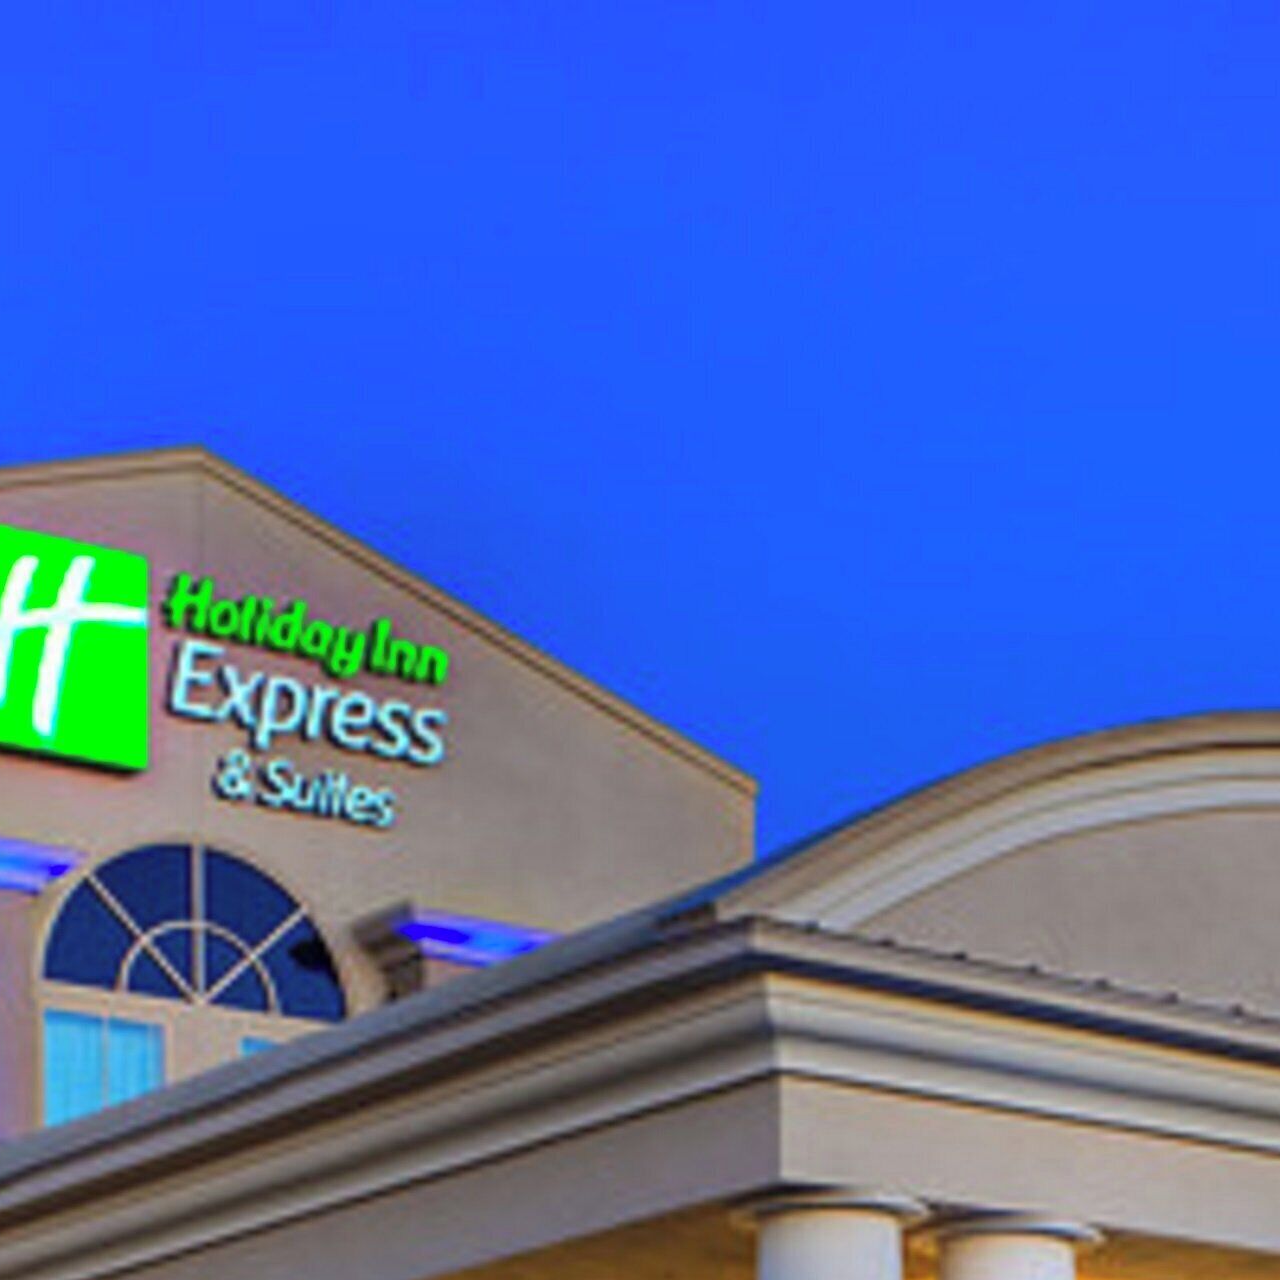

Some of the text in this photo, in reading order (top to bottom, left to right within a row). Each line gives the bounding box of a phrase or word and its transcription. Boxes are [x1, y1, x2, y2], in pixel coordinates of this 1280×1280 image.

[166, 572, 449, 685] Holiday Inn
[169, 639, 448, 765] Express
[213, 748, 397, 829] & Suites
